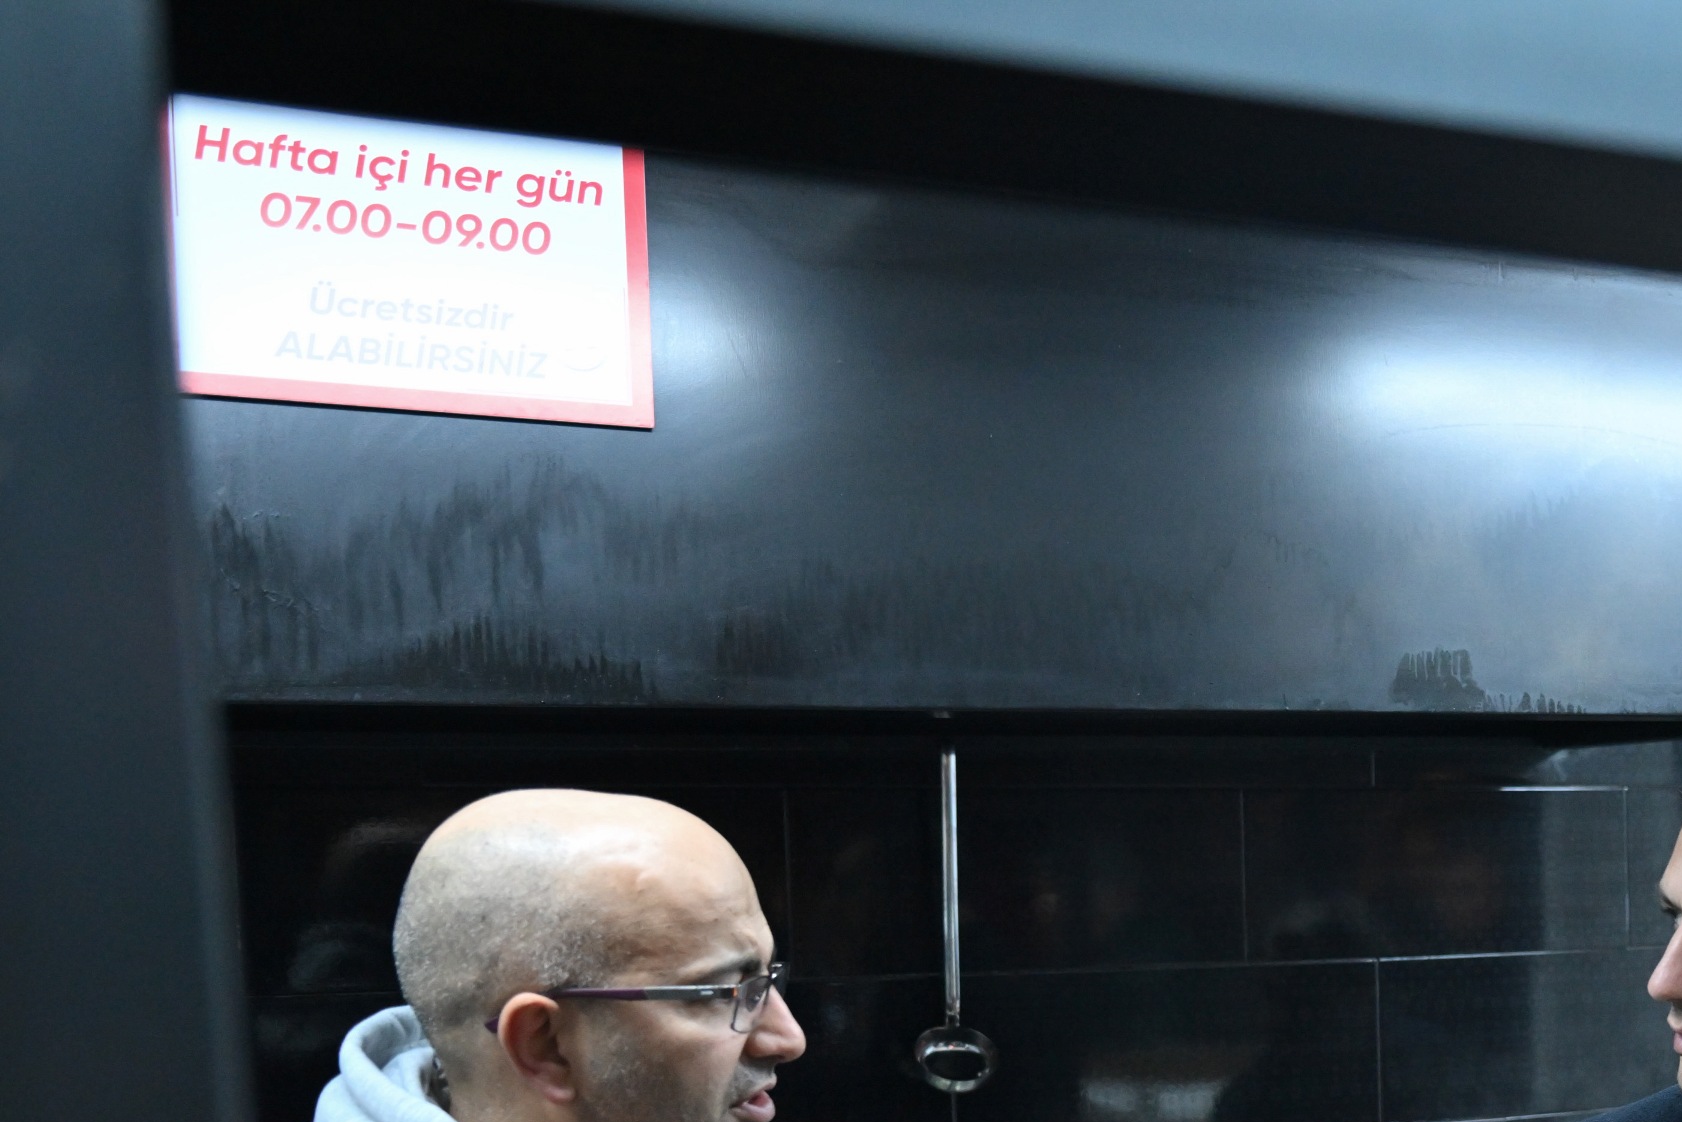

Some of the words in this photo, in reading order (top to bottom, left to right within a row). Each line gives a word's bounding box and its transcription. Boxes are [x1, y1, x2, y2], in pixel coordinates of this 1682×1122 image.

[194, 124, 339, 176] Hafta
[355, 143, 411, 191] içi
[423, 152, 503, 195] her
[516, 169, 604, 209] gün
[309, 280, 515, 332] Ücretsizdir
